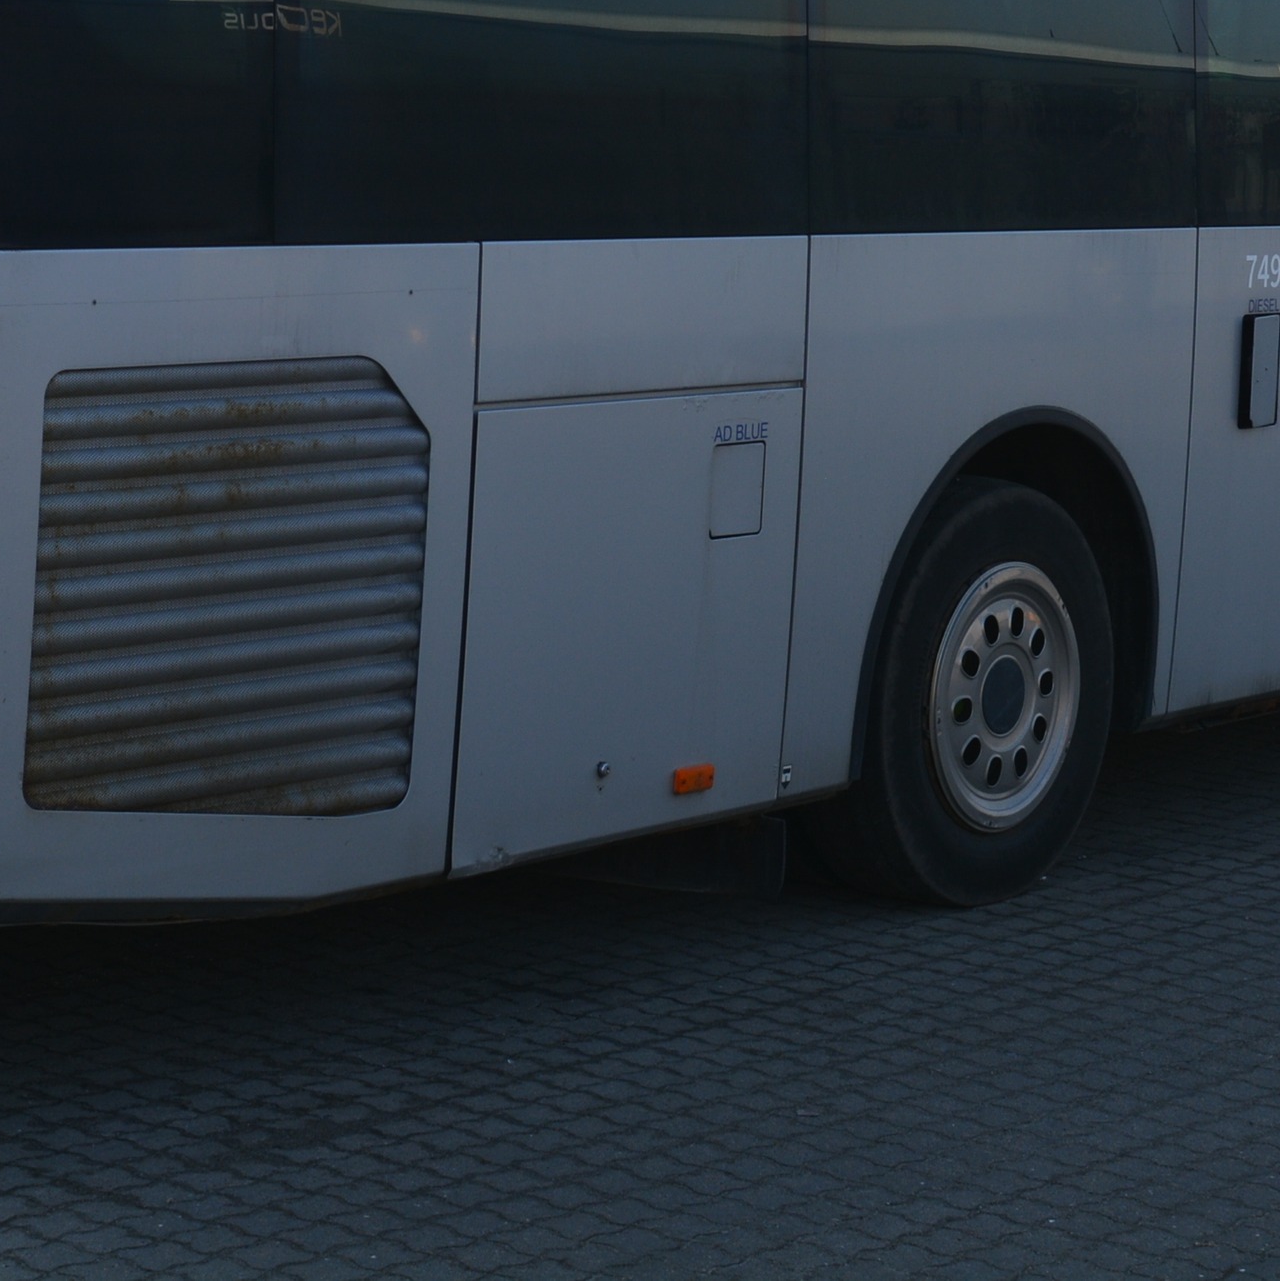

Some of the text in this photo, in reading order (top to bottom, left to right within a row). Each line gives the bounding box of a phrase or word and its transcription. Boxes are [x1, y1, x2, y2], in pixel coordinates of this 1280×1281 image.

[1248, 298, 1280, 313] DIESEL
[714, 422, 769, 442] AD BLUE
